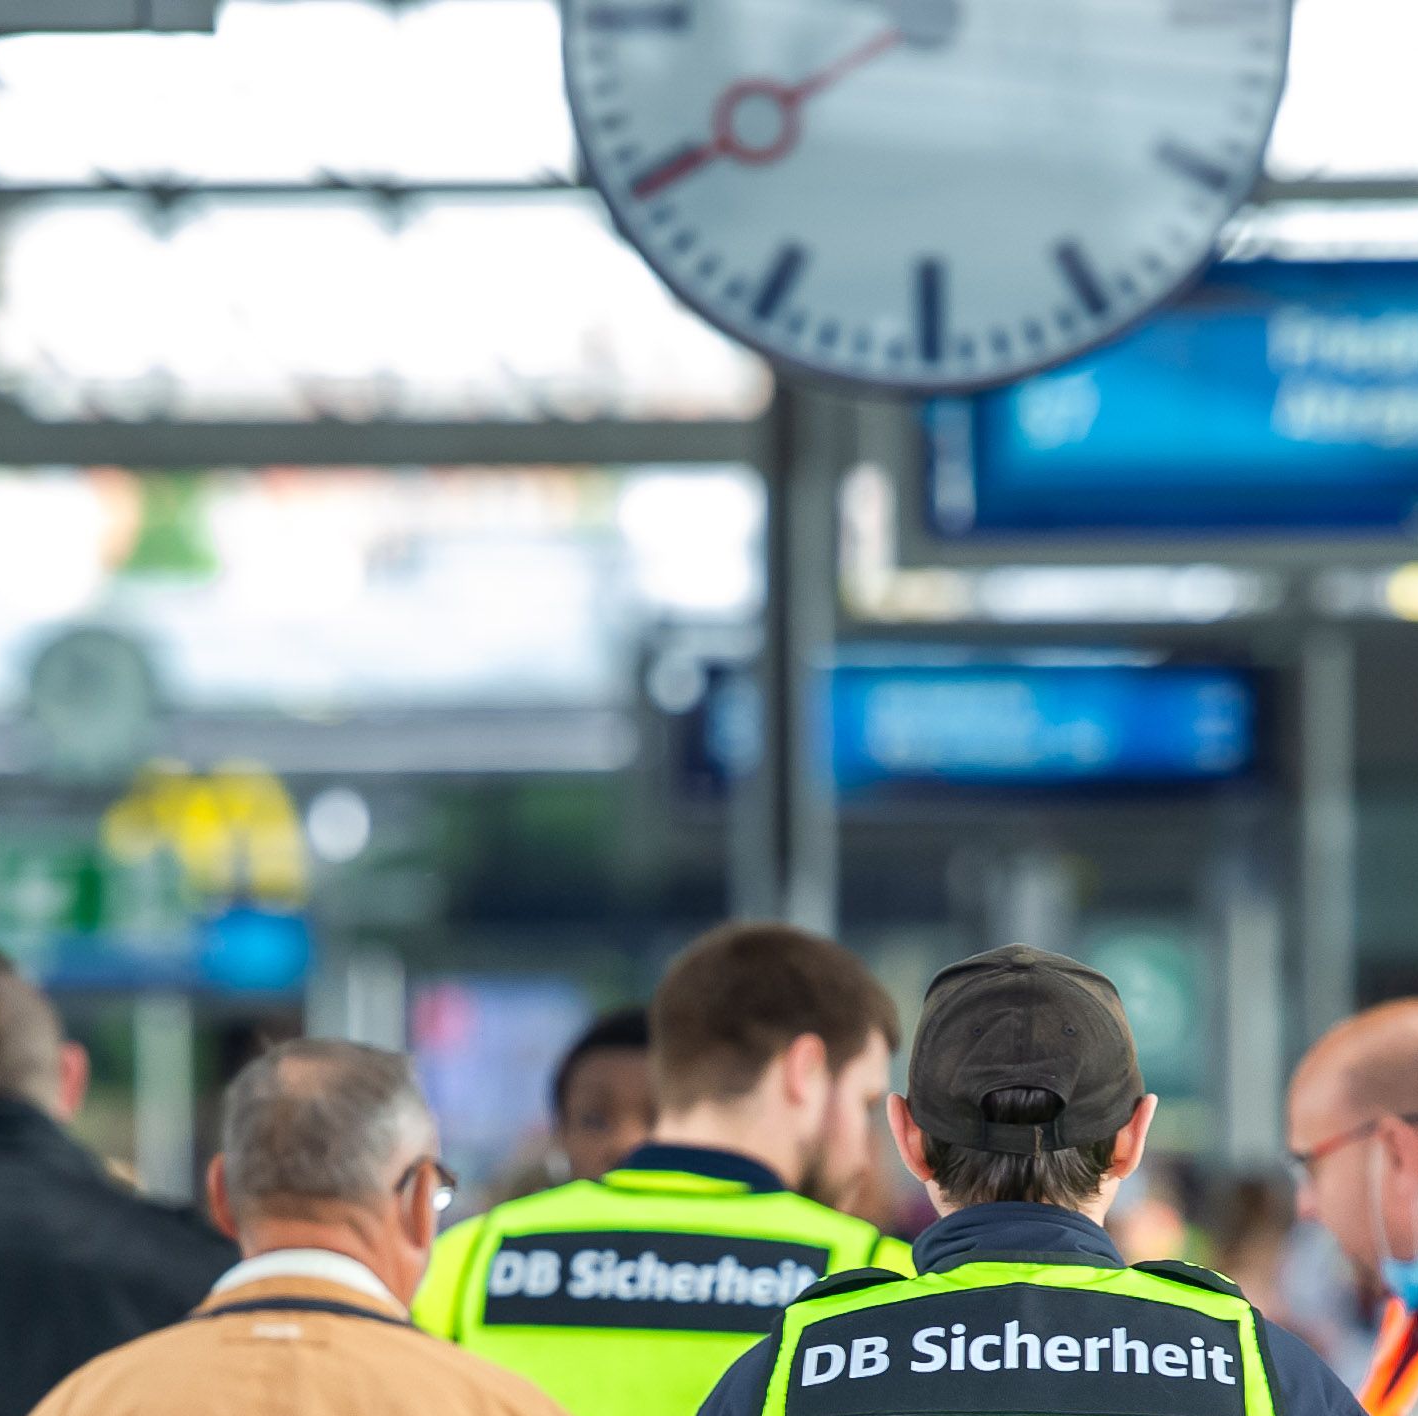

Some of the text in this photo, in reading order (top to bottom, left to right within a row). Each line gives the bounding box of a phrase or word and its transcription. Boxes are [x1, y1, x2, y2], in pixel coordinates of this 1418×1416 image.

[488, 1249, 561, 1297] DB
[801, 1320, 1236, 1387] DB Sicherheit
